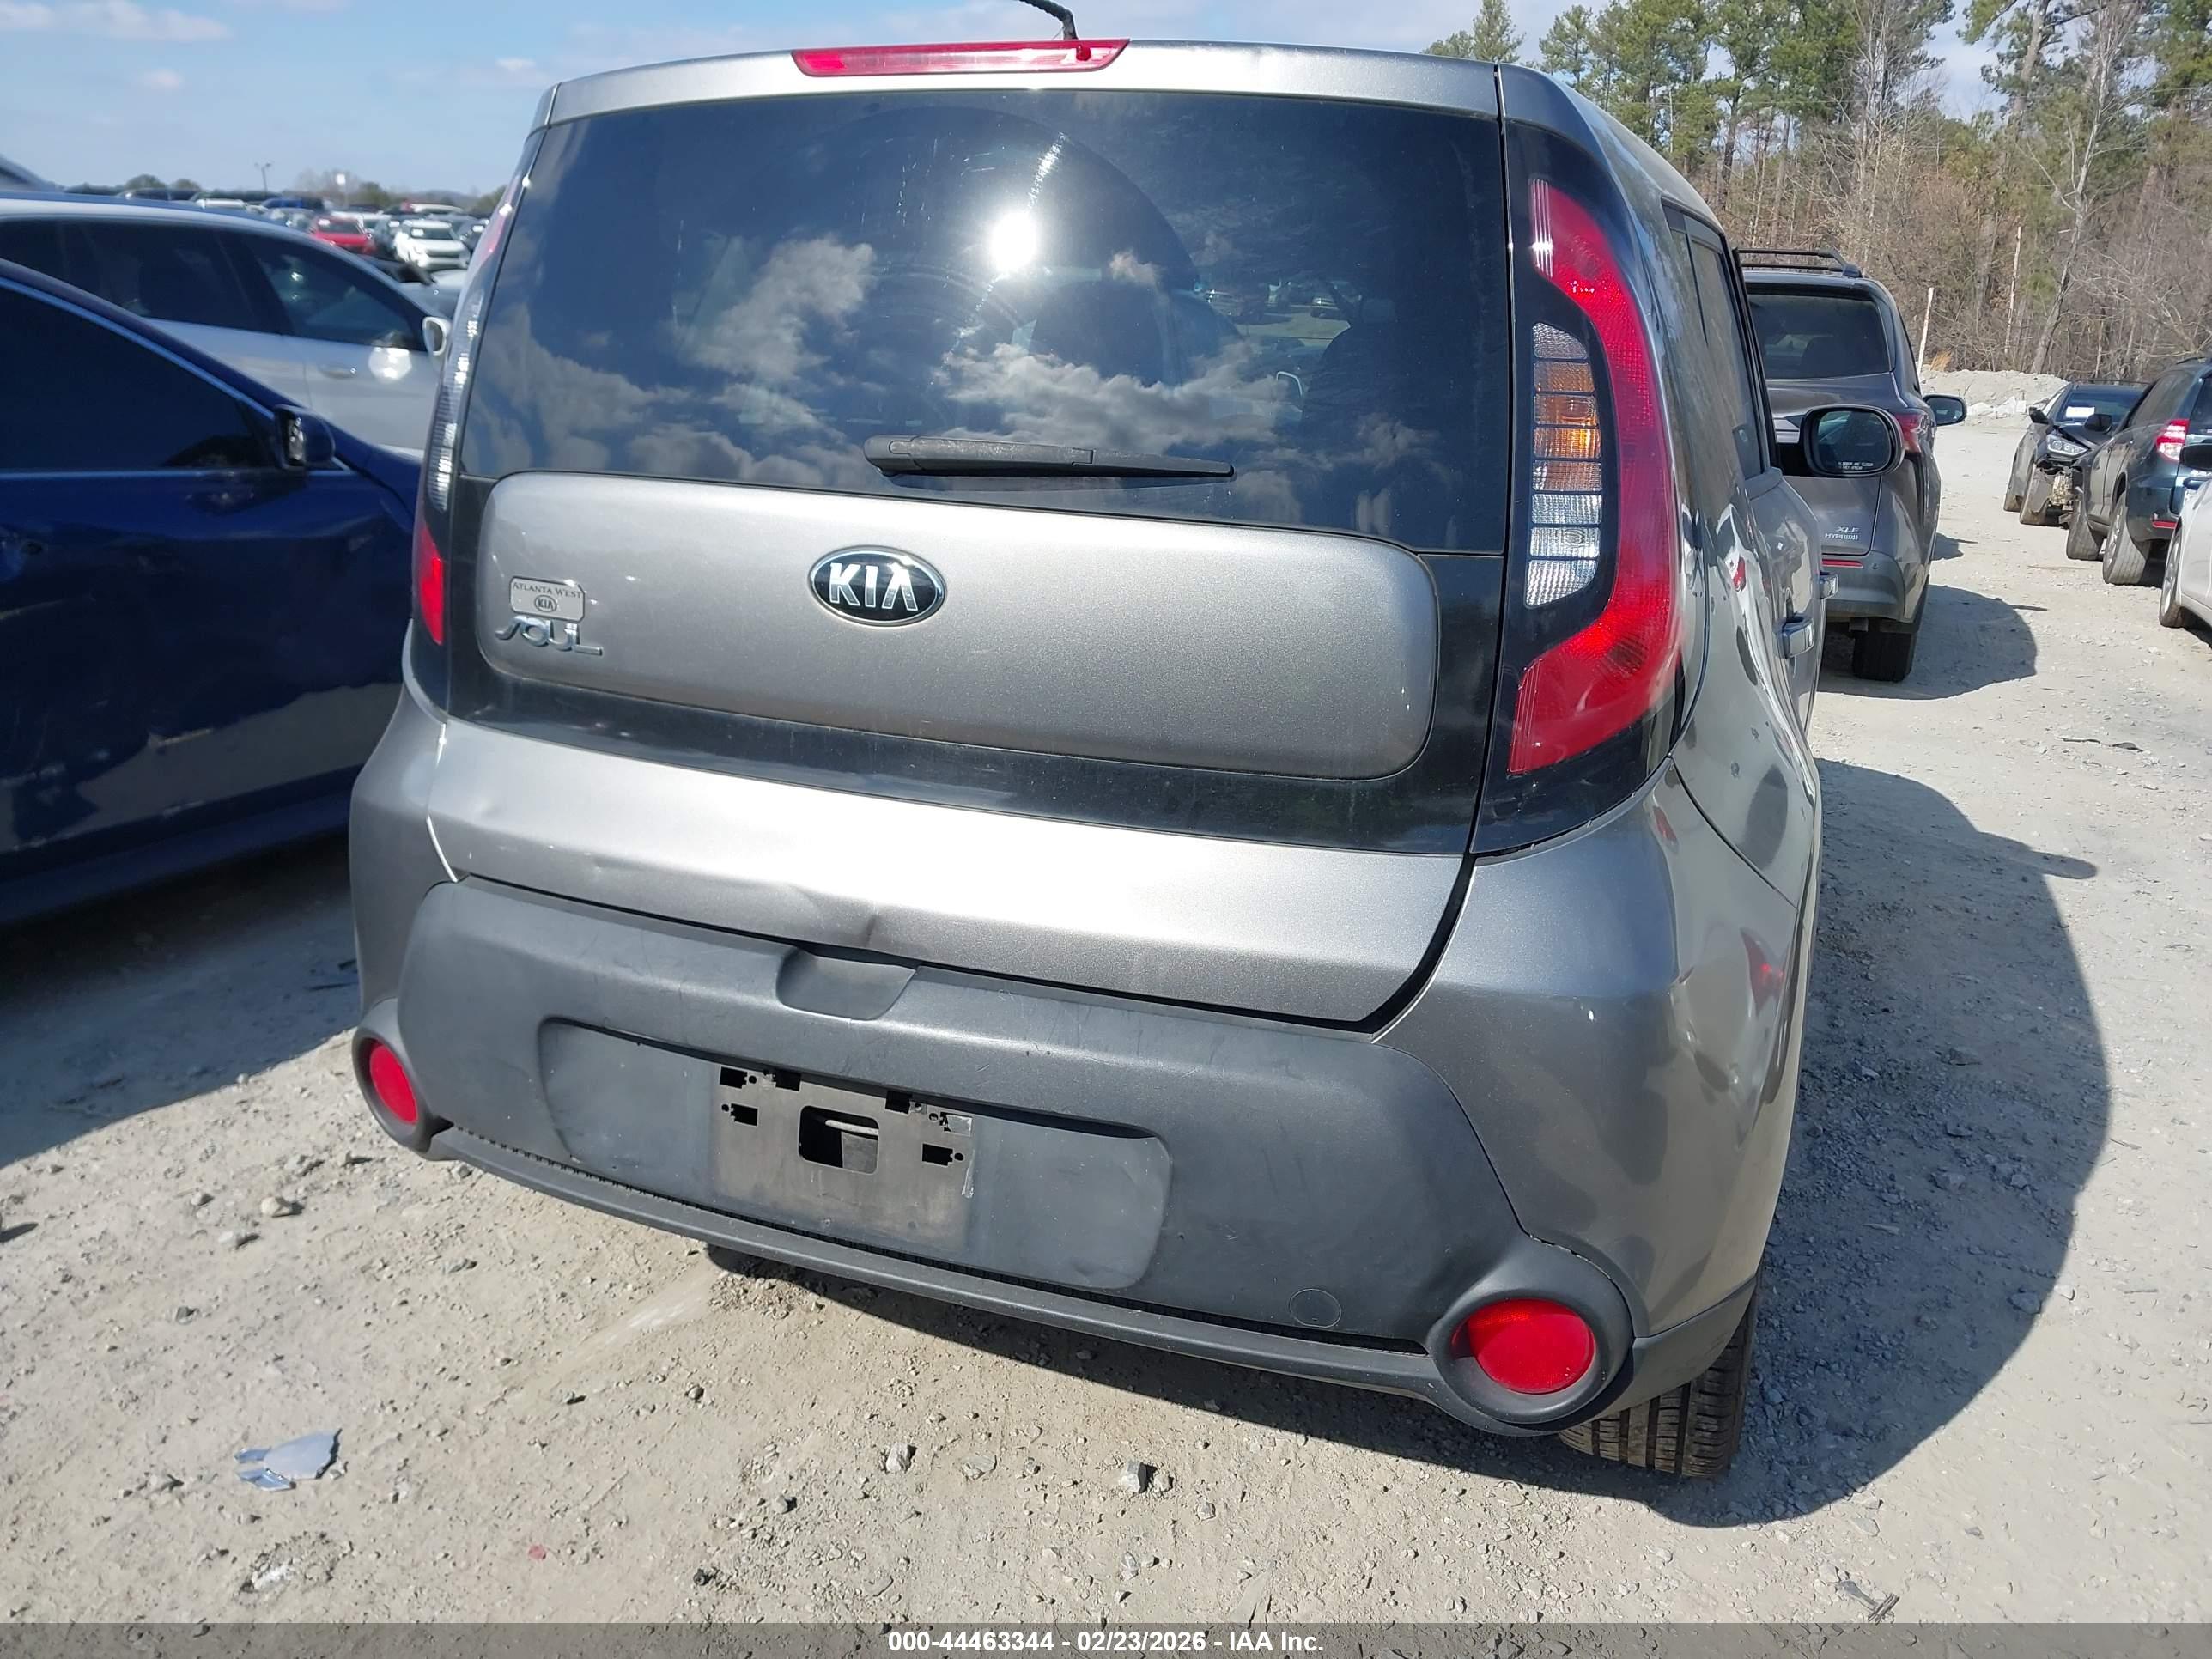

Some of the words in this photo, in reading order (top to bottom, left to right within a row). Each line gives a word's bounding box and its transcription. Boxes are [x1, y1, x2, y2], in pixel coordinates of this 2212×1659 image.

[513, 582, 552, 595] ATLANTA
[555, 587, 582, 599] WEST
[830, 562, 919, 611] KIA
